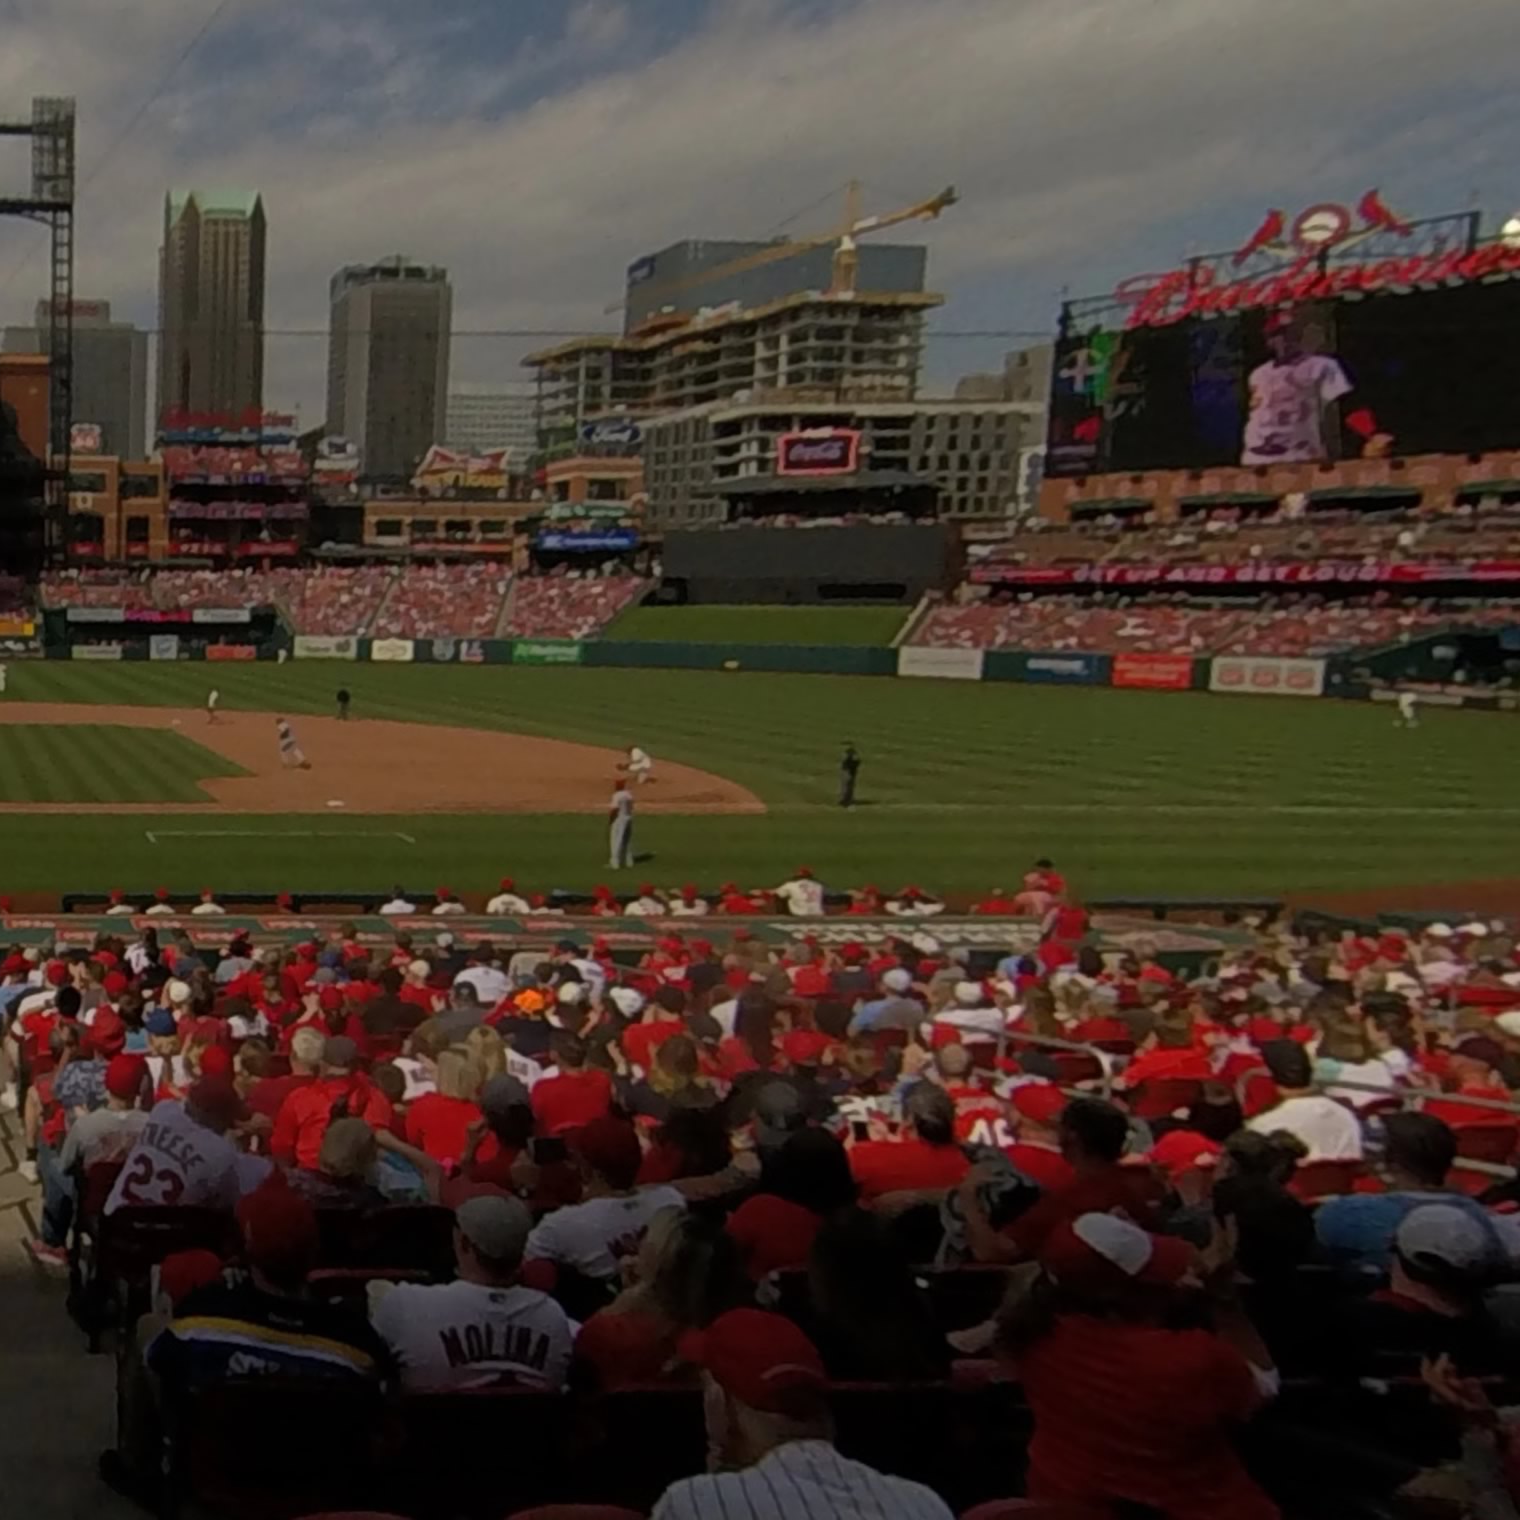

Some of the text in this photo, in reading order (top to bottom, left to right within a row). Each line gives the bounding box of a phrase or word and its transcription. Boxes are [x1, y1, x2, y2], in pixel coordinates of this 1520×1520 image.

[1072, 565, 1123, 582] GET
[1123, 565, 1163, 582] UP
[1165, 566, 1227, 582] AND
[1235, 565, 1295, 582] GET
[121, 1153, 184, 1204] 23
[439, 1323, 550, 1369] MOLINA
